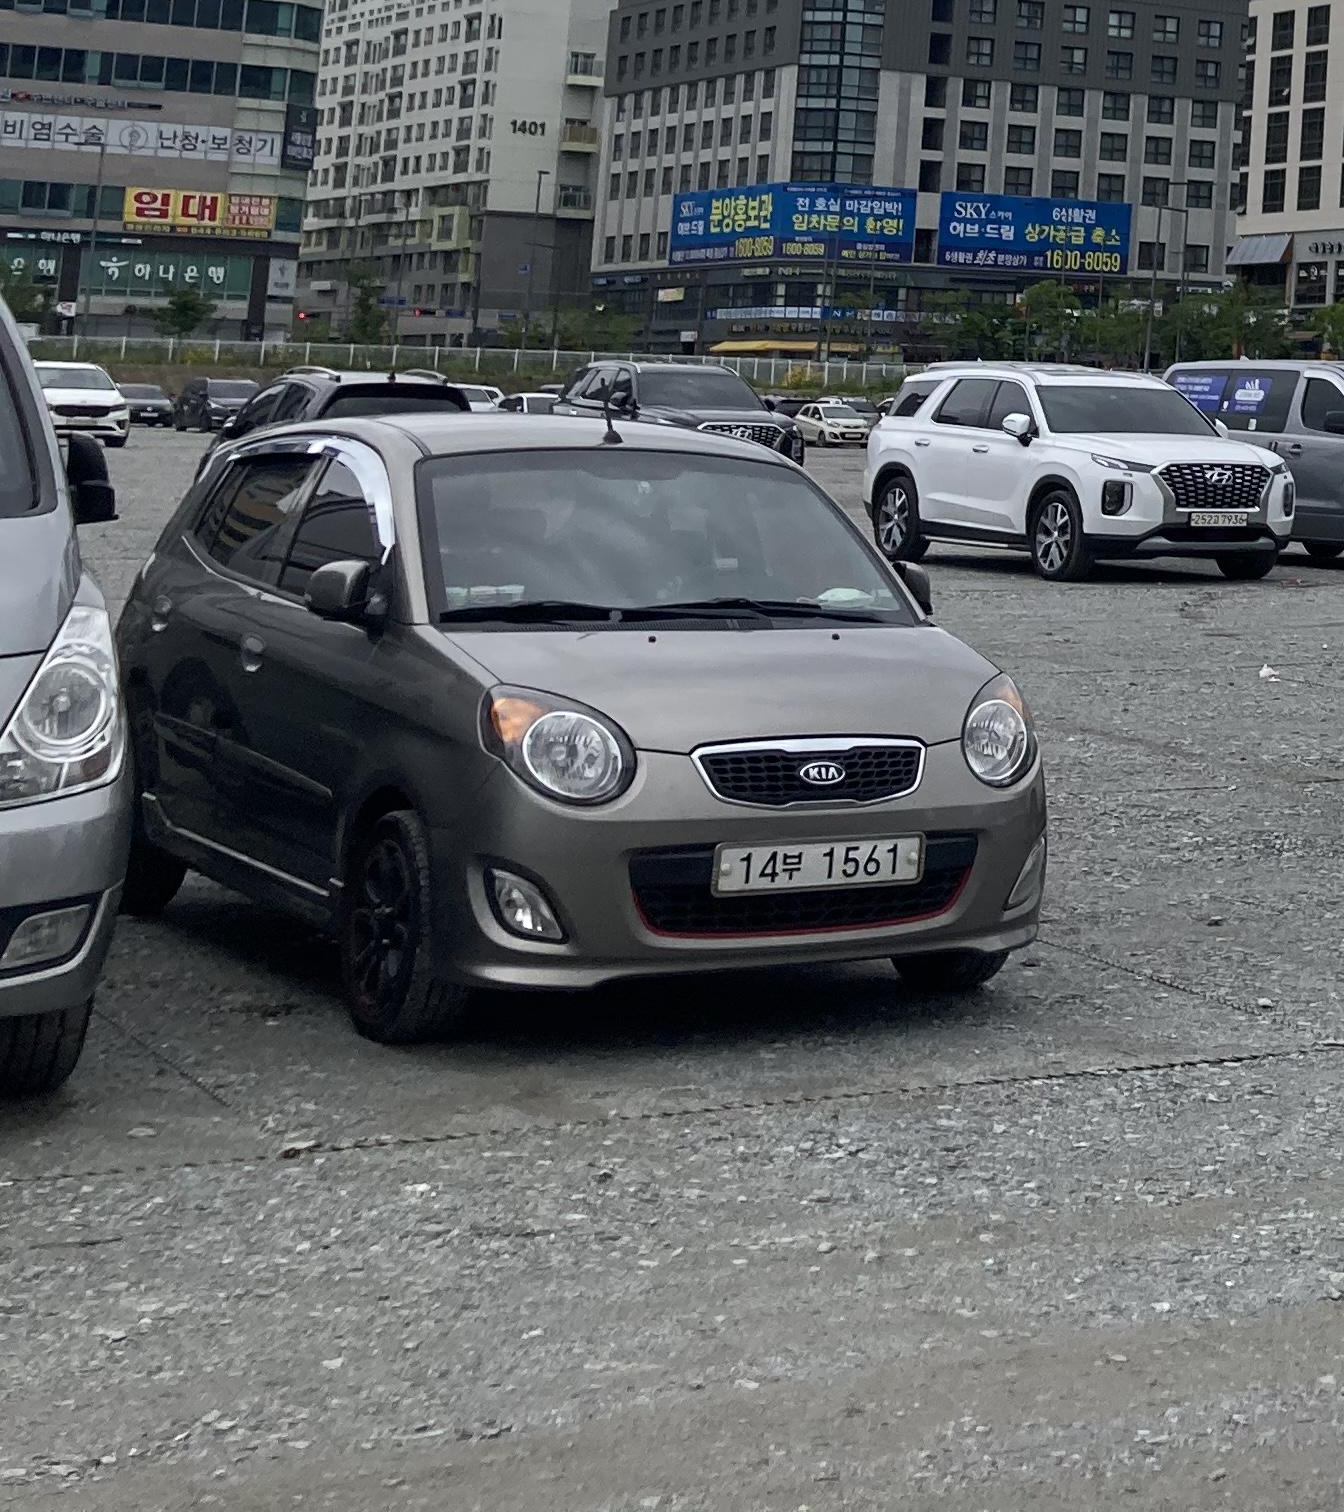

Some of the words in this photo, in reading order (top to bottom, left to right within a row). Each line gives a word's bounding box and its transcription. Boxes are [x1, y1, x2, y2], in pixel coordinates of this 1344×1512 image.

[4, 119, 105, 145] 비염수술
[158, 128, 276, 159] 난청·보청기
[510, 119, 546, 137] 1401
[133, 191, 219, 223] 임대
[709, 191, 773, 234] 분양홍보관
[954, 201, 991, 219] SKY
[11, 257, 56, 276] 은행
[134, 262, 225, 285] 하나은행
[808, 766, 840, 780] KIA
[739, 851, 803, 885] 14부
[822, 843, 899, 880] 1561
